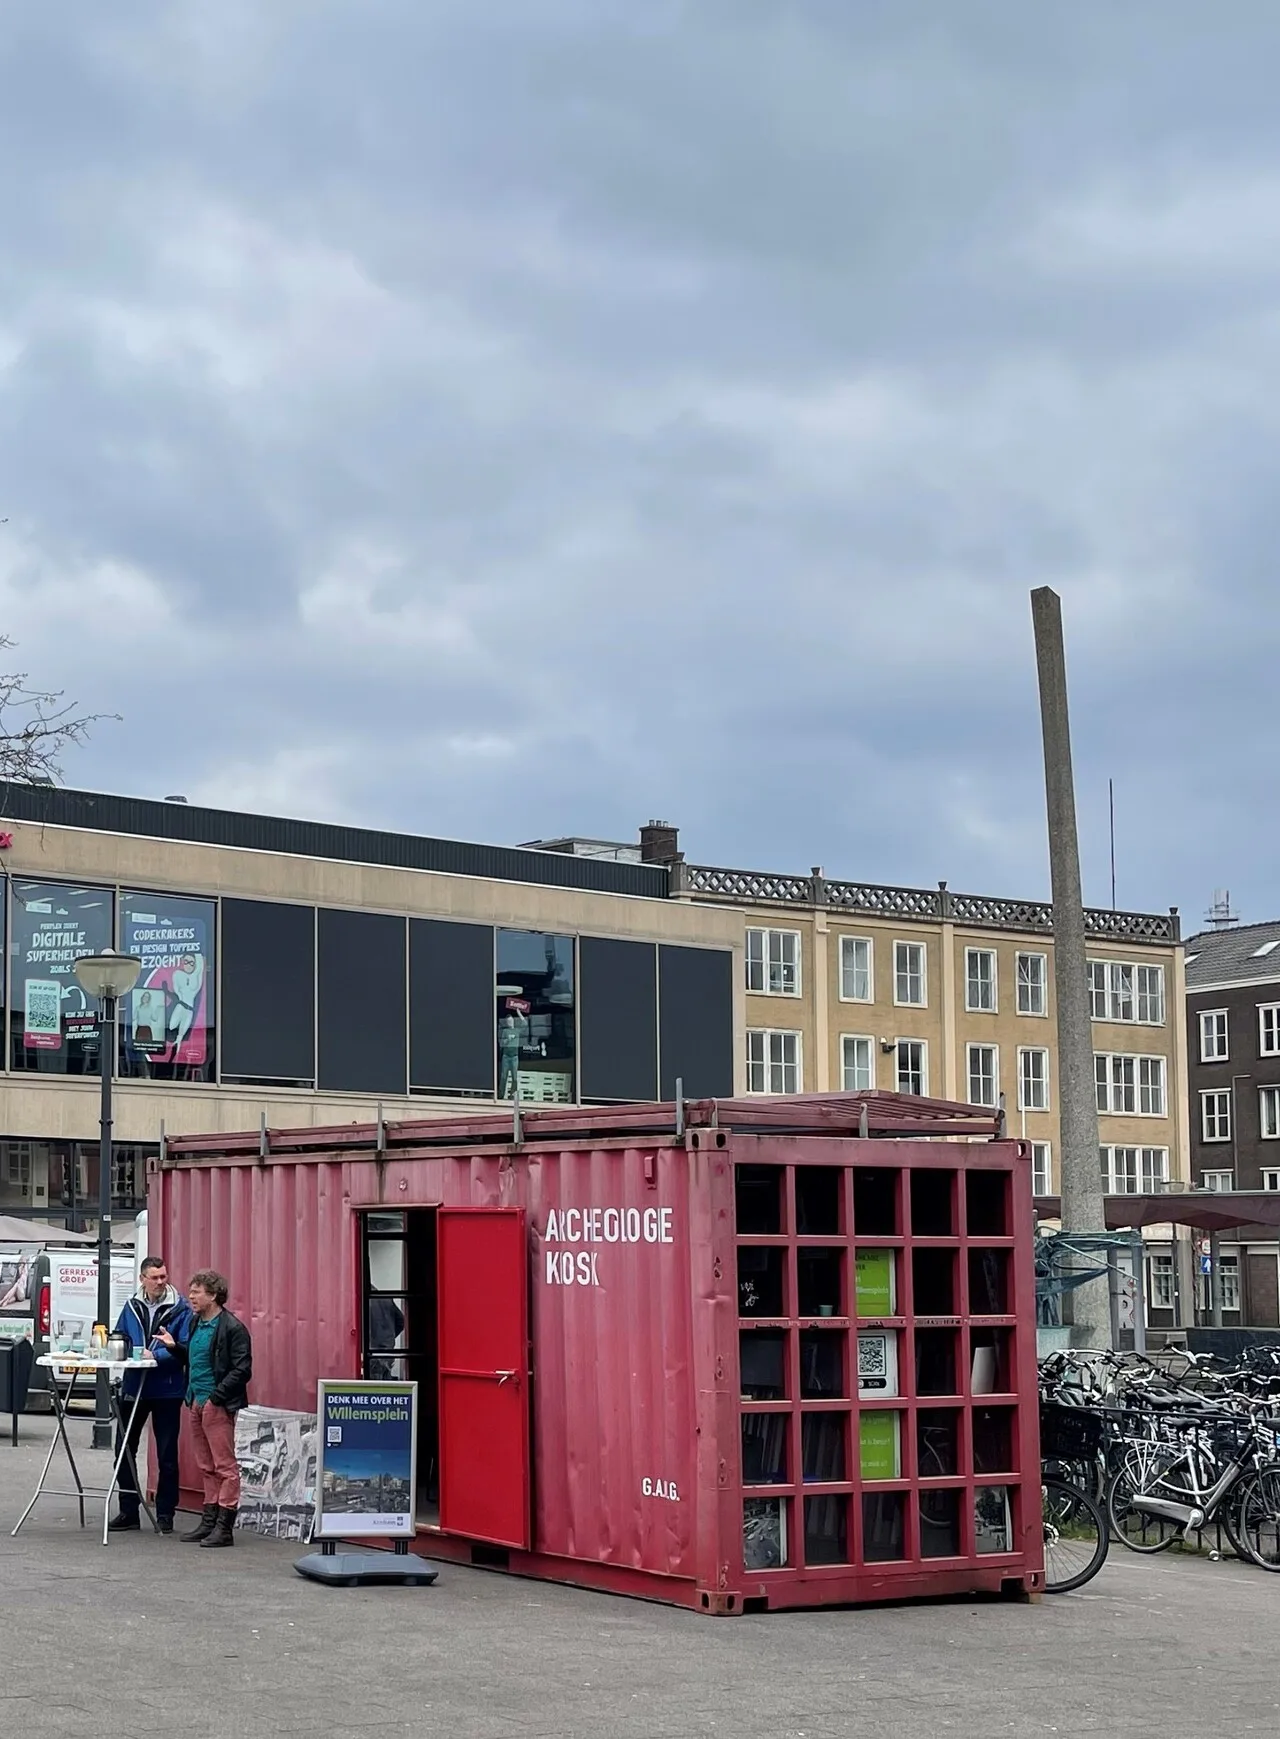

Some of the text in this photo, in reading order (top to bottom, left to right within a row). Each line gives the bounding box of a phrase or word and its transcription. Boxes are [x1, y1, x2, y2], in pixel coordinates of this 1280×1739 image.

[32, 931, 86, 948] DIGITALE
[133, 928, 195, 941] CODEKRAKERS
[130, 942, 200, 954] EN DESIGN TOPPERS
[26, 948, 95, 963] SUPERHELDEN
[138, 954, 183, 969] EZOCHT
[59, 1268, 99, 1277] GERRESSE
[59, 1276, 87, 1284] GROEP
[328, 1395, 409, 1405] DENK MEE OVER HET
[328, 1406, 409, 1424] Willemsplein
